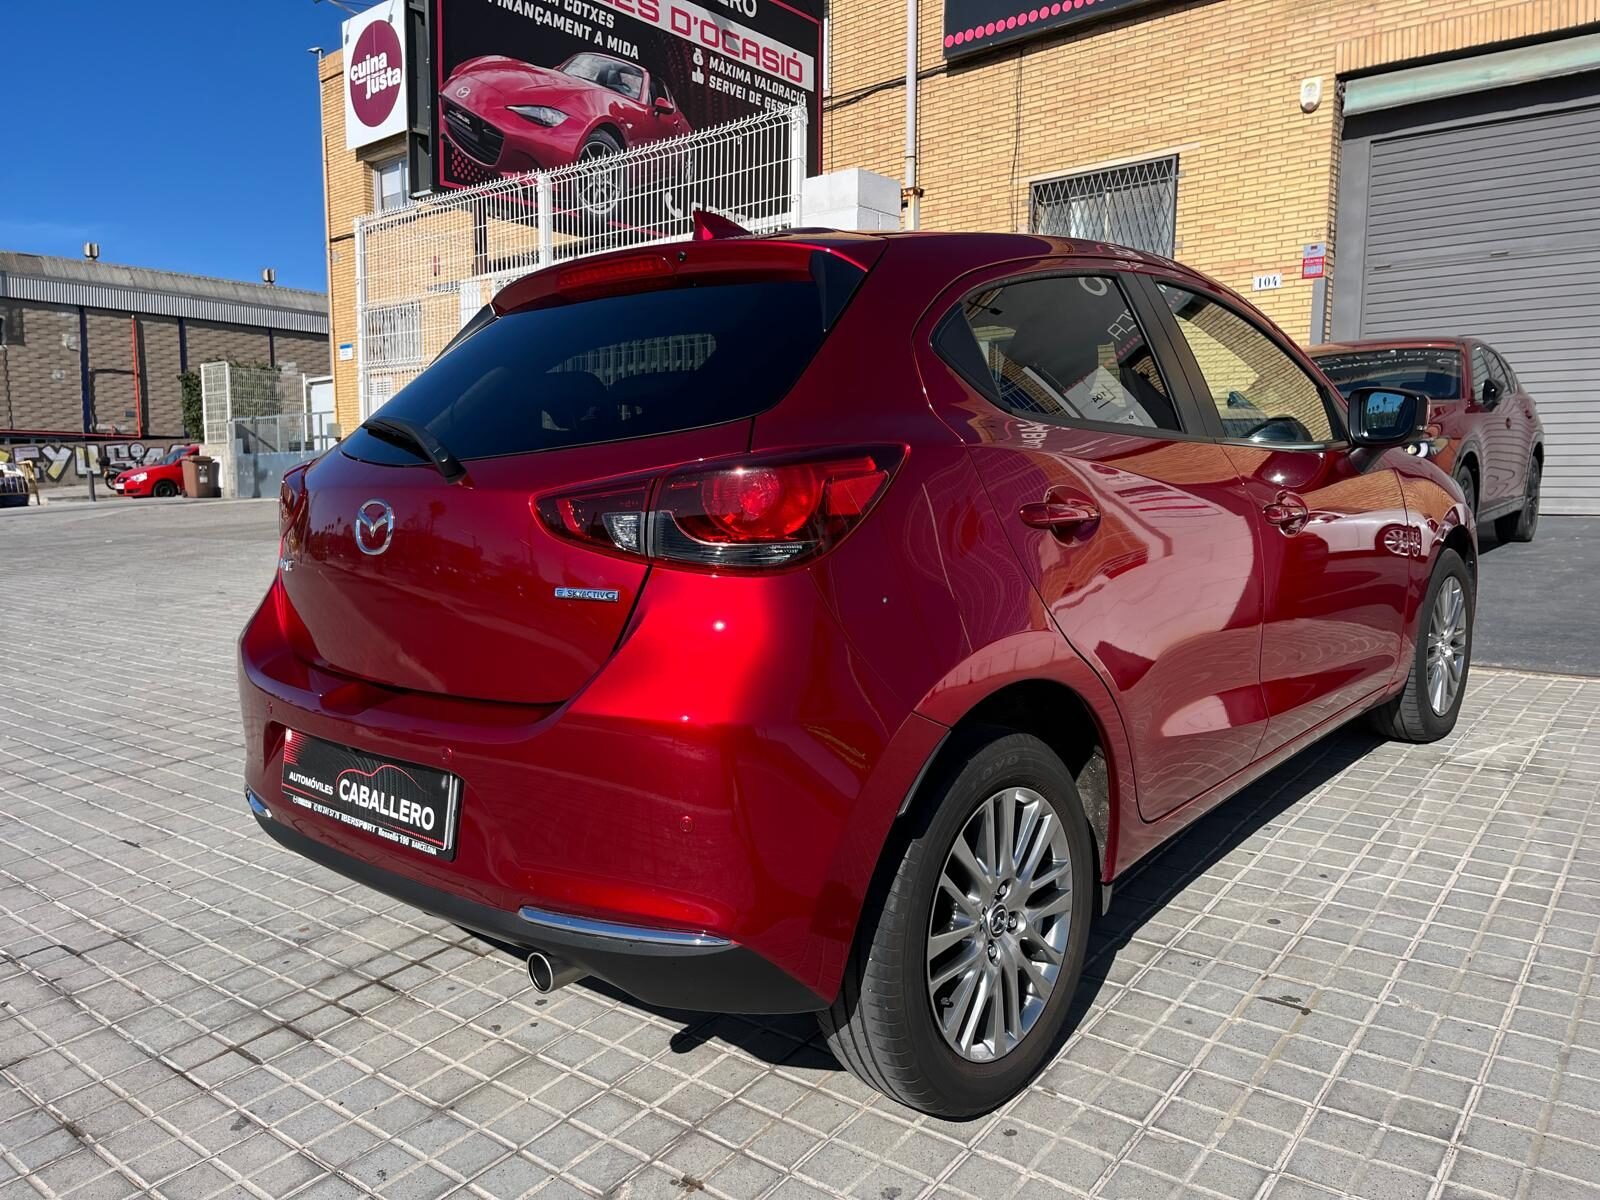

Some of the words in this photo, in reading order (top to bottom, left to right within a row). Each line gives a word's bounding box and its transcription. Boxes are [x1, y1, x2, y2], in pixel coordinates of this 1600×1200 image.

[594, 31, 604, 47] A
[607, 35, 640, 60] MIDA
[350, 51, 388, 82] cuina
[708, 56, 751, 85] MÀXIMA
[754, 74, 807, 108] VALORACIÓ
[365, 66, 402, 101] justa
[708, 75, 747, 100] SERVEI
[748, 89, 763, 106] DE
[1258, 276, 1278, 289] 104
[289, 771, 334, 795] AUTOMÓVILES
[339, 778, 435, 830] CABALLERO
